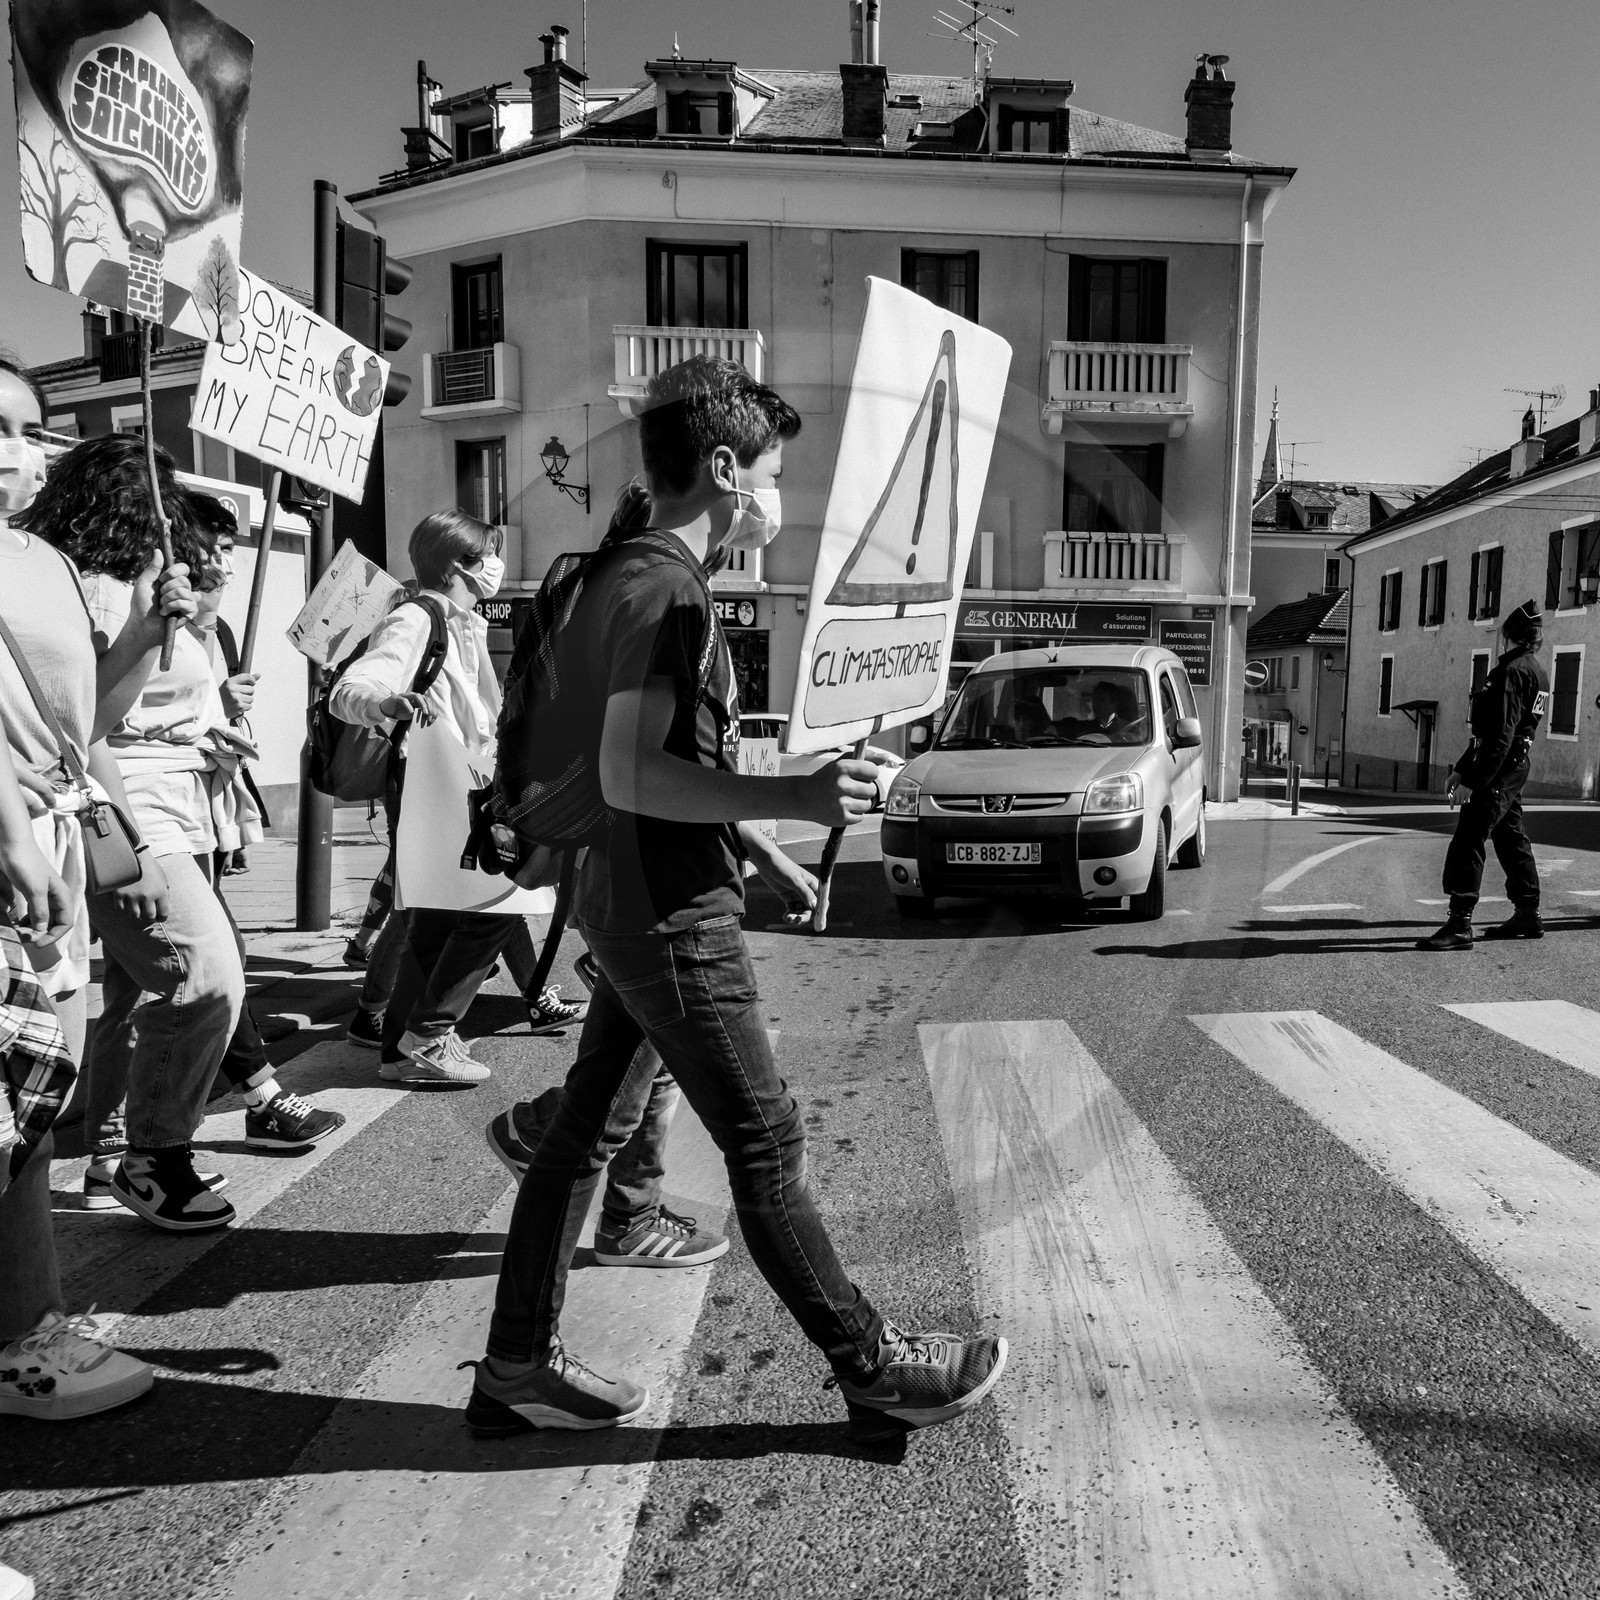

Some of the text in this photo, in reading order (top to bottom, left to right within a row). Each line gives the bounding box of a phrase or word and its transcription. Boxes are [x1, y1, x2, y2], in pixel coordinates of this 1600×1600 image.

[97, 46, 135, 80] TA
[185, 133, 207, 175] OU
[220, 319, 331, 397] BREAK
[201, 378, 248, 434] MY
[485, 603, 512, 619] SHOP
[1115, 614, 1147, 622] Solutions
[991, 611, 1078, 629] GENERALI
[1102, 622, 1146, 630] d'assurances
[1165, 632, 1207, 640] PARTICULIERS
[957, 846, 1030, 862] CB-882-ZJ
